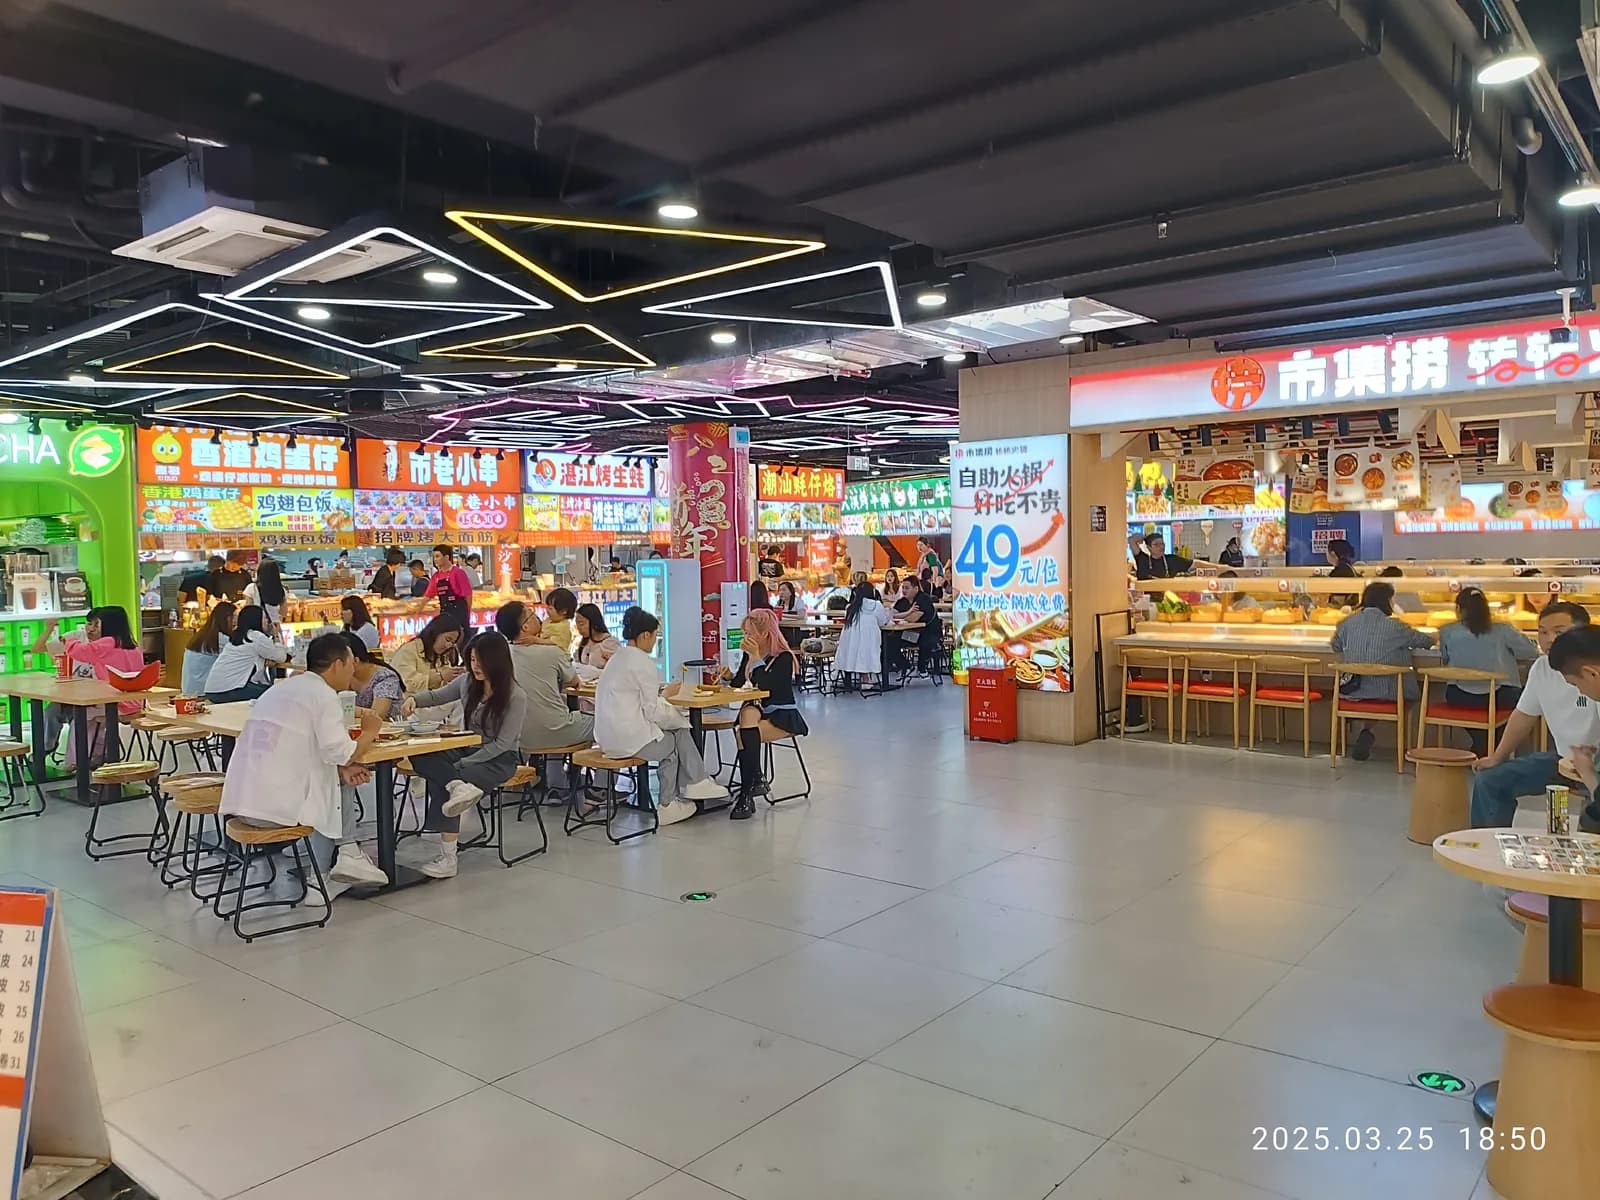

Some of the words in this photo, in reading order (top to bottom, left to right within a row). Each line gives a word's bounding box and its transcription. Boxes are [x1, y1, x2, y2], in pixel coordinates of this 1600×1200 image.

[1278, 336, 1449, 401] 市集捞
[191, 437, 338, 472] 香港鸡蛋仔
[559, 462, 645, 489] 湛江烤生蚝
[959, 460, 1043, 489] 自助火锅
[762, 469, 836, 498] 潮汕蚝仔烙
[142, 485, 241, 500] 香港鸡蛋仔
[257, 493, 332, 513] 鸡翅包饭
[974, 489, 1061, 516] 好吃不贵
[259, 534, 336, 546] 鸡翅包饭
[374, 530, 494, 544] 招牌烤大面筋
[955, 523, 1020, 588] 49
[1019, 557, 1059, 585] 元/位
[24, 929, 36, 943] 21
[22, 954, 33, 968] 24
[19, 980, 31, 993] 25
[16, 1005, 28, 1018] 25
[13, 1030, 25, 1044] 26
[10, 1056, 21, 1070] 31
